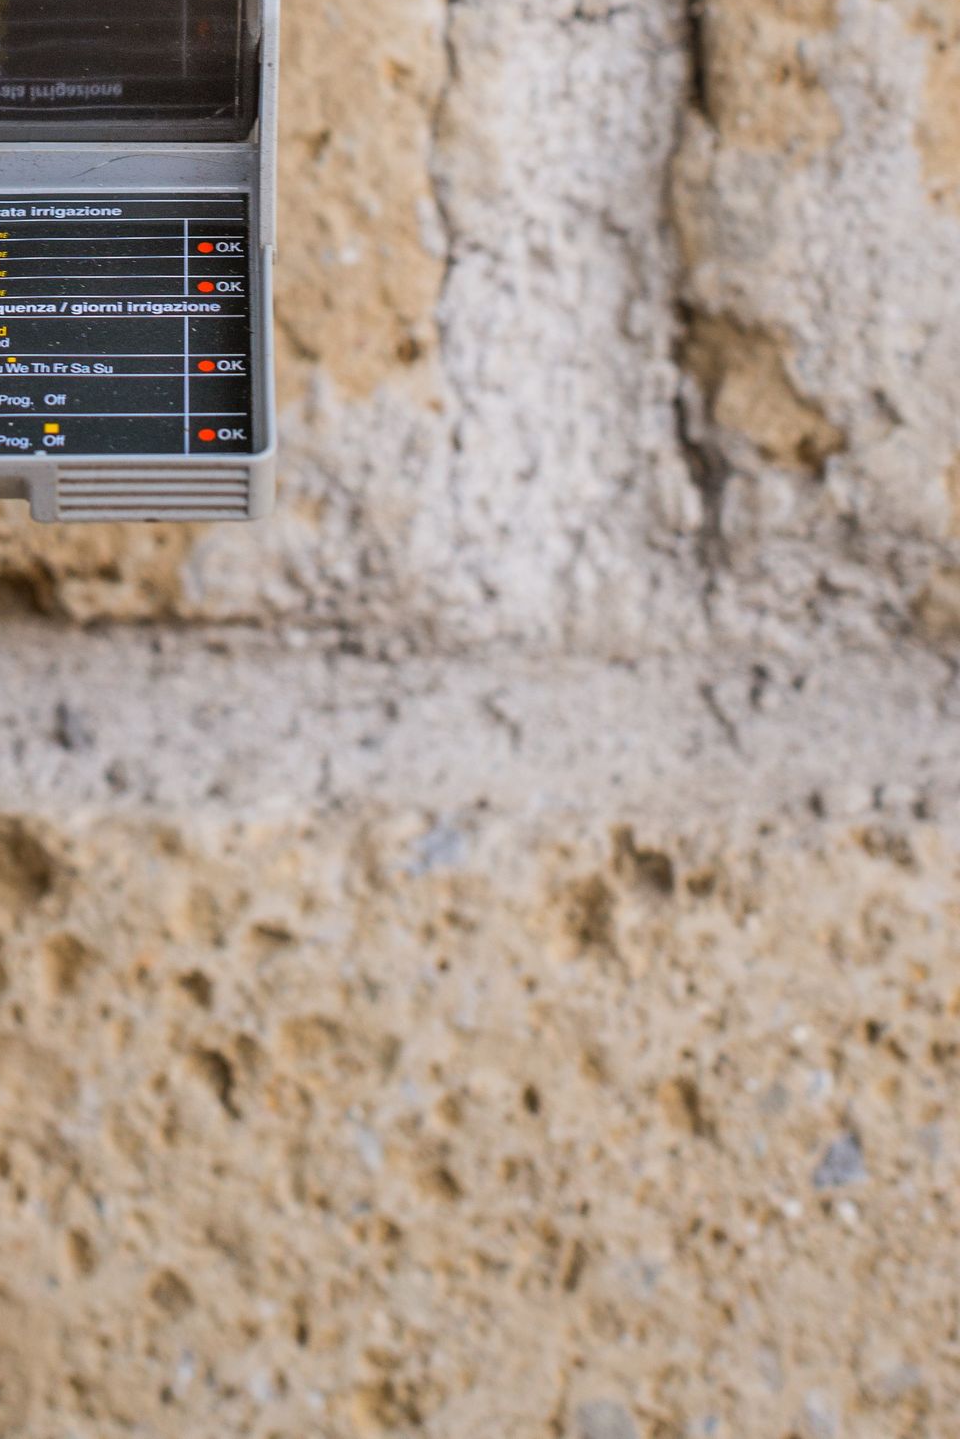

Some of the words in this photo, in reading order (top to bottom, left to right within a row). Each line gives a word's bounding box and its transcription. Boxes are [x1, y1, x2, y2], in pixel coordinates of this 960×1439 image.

[31, 206, 122, 218] irrigazione
[215, 242, 243, 252] O.K.
[216, 281, 244, 292] O.K.
[71, 302, 123, 314] giorni
[127, 302, 221, 314] irrigazione
[5, 363, 29, 374] We
[31, 363, 50, 374] Th
[53, 363, 68, 374] Fr
[70, 363, 90, 374] Sa
[93, 363, 114, 374] Su
[216, 360, 246, 371] O.K.
[44, 394, 67, 406] Off
[42, 434, 66, 447] Off
[217, 428, 247, 440] O.K.
